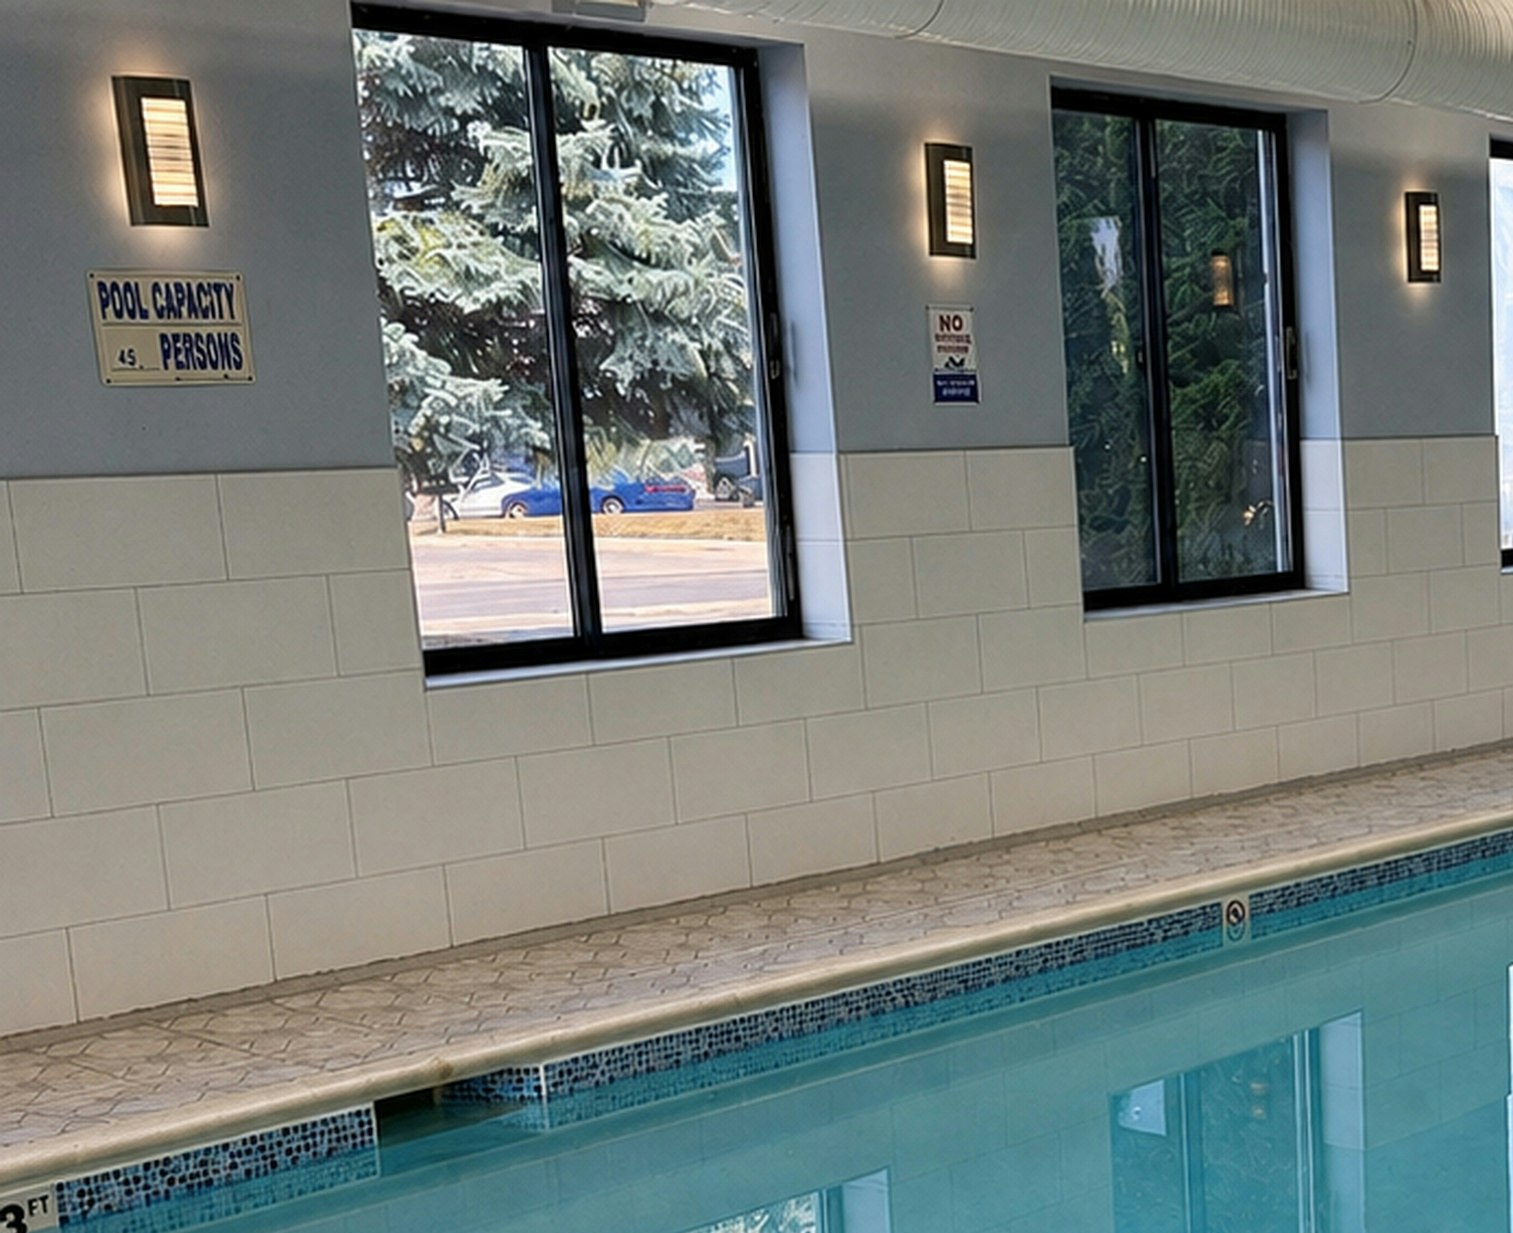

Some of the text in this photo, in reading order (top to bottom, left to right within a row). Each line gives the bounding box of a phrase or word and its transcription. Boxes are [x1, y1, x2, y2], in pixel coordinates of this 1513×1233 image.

[97, 281, 236, 321] POOL CAPACITY
[938, 314, 963, 332] NO
[117, 332, 244, 370] 45 PERSONS
[27, 1194, 49, 1217] FT
